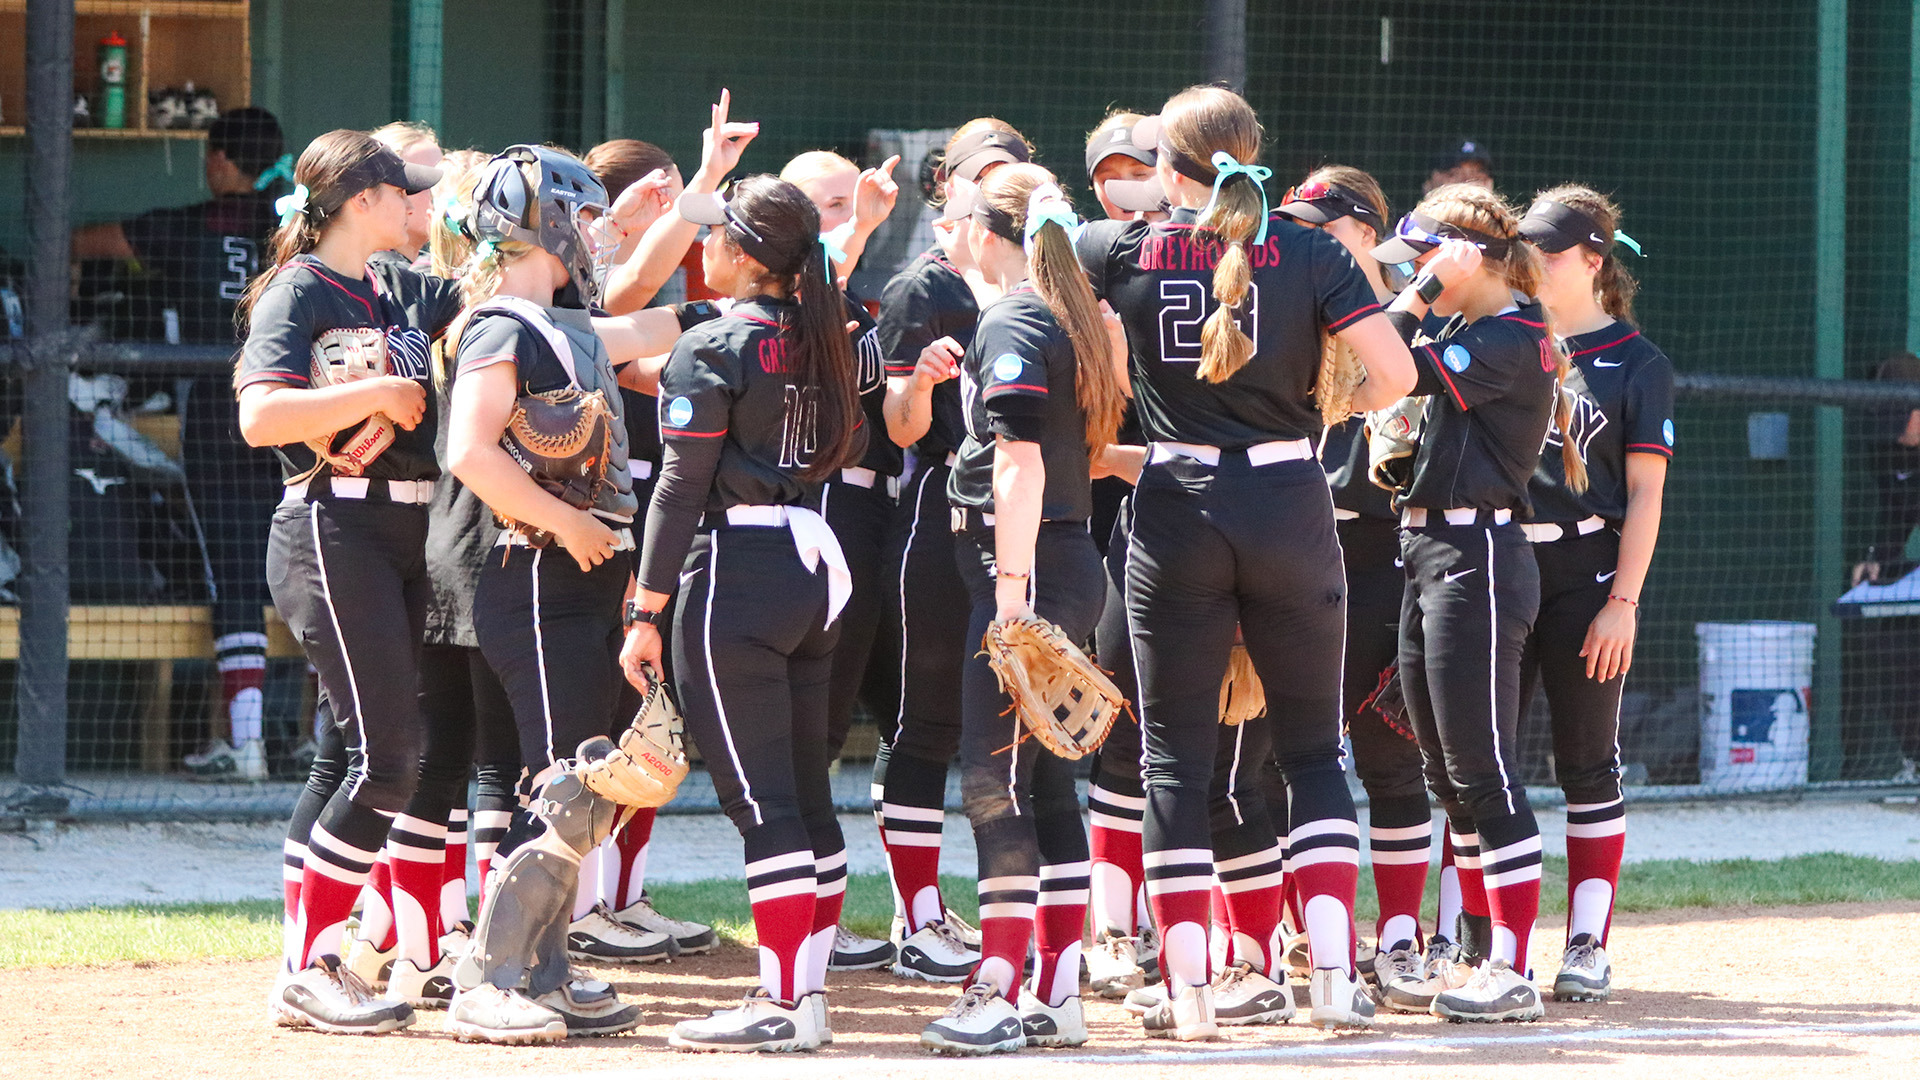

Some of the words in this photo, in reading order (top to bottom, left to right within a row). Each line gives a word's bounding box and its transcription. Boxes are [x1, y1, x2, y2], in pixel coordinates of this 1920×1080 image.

[551, 187, 577, 198] EASTON
[1138, 235, 1281, 271] GREYHODS
[352, 426, 386, 459] Wilson
[641, 752, 673, 777] A2000
